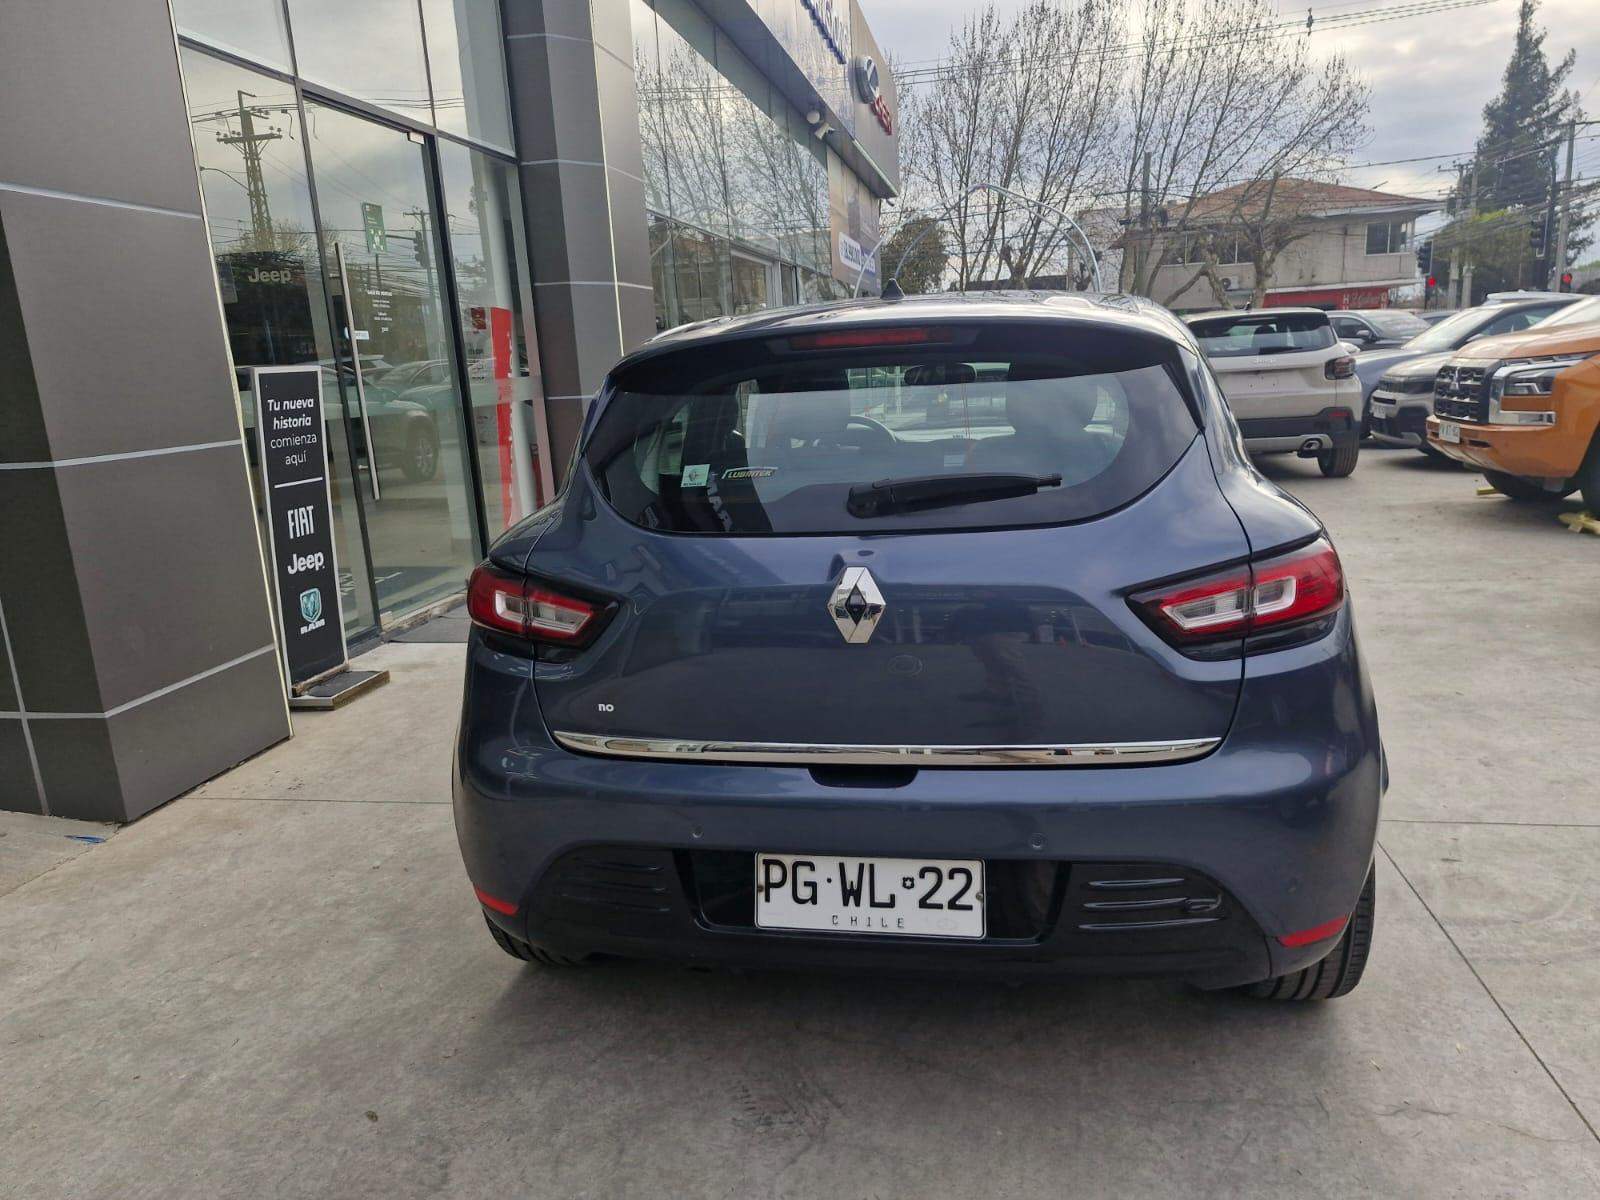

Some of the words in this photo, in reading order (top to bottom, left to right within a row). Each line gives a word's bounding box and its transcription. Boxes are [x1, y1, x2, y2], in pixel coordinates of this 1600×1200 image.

[248, 268, 292, 283] Jeep
[267, 399, 281, 412] Tu
[283, 398, 315, 410] nueva
[273, 413, 312, 430] historia
[270, 433, 317, 449] comienza
[285, 450, 307, 466] aquí
[287, 505, 315, 539] FIAT
[832, 915, 905, 929] CHILE
